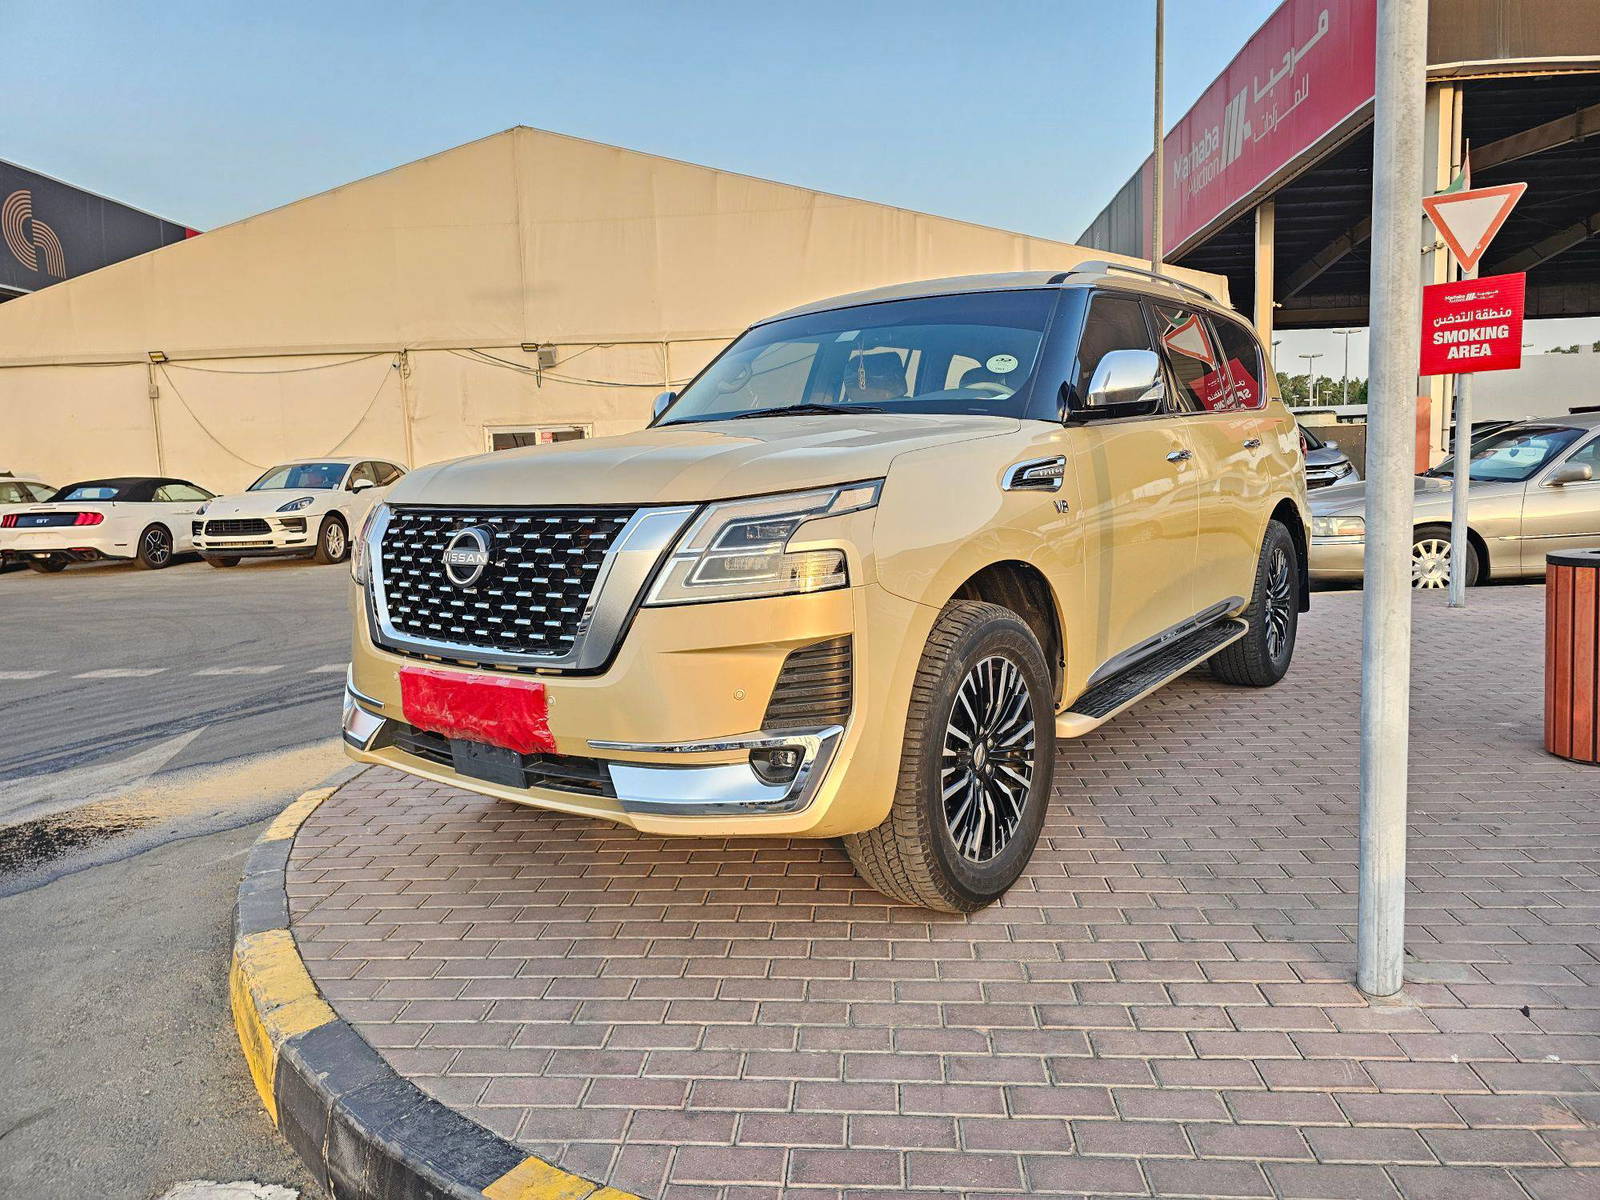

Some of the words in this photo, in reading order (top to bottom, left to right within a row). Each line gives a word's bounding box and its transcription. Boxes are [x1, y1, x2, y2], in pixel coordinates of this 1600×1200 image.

[1253, 8, 1329, 104] مرحبا
[1173, 124, 1220, 190] Marhaba
[1186, 156, 1220, 200] Auction
[1474, 307, 1512, 321] منطقة
[1433, 324, 1510, 346] SMOKING
[1446, 343, 1493, 360] AREA
[1053, 499, 1069, 514] V8
[442, 551, 487, 564] NISSAN
